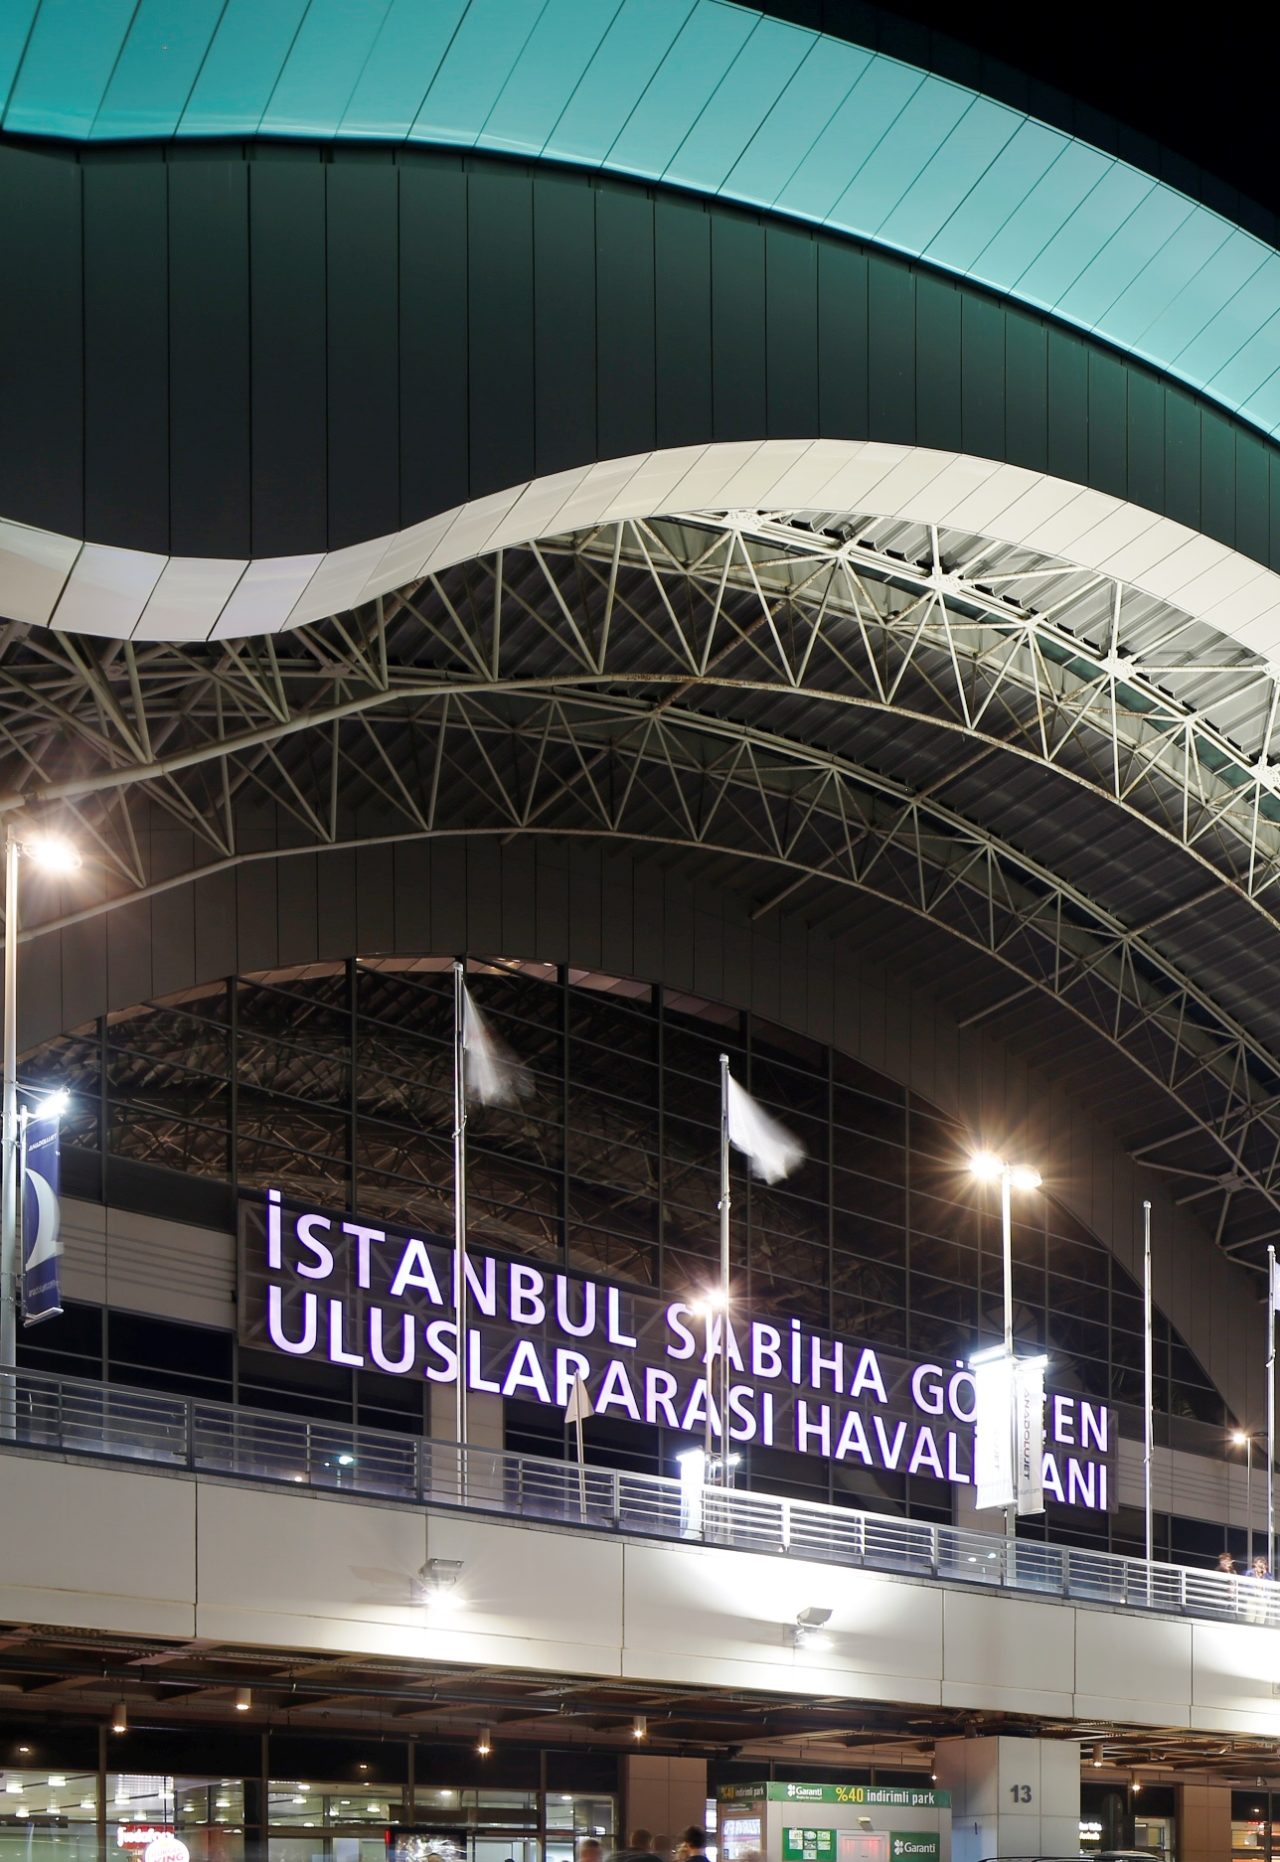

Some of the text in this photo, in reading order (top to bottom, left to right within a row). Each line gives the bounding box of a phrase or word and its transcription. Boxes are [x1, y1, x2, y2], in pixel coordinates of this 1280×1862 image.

[267, 1188, 638, 1349] İSTANBUL
[665, 1302, 888, 1404] SABİHA
[911, 1359, 1109, 1453] GÖEN
[267, 1285, 1108, 1511] ULUSLARARASI HAVALANI
[1023, 1387, 1031, 1481] ANADOLUJET
[795, 1786, 823, 1797] Garanti
[835, 1786, 864, 1803] %40
[867, 1789, 909, 1804] indirimli
[911, 1791, 935, 1805] park
[1010, 1784, 1032, 1803] 13
[903, 1841, 936, 1853] Garanti
